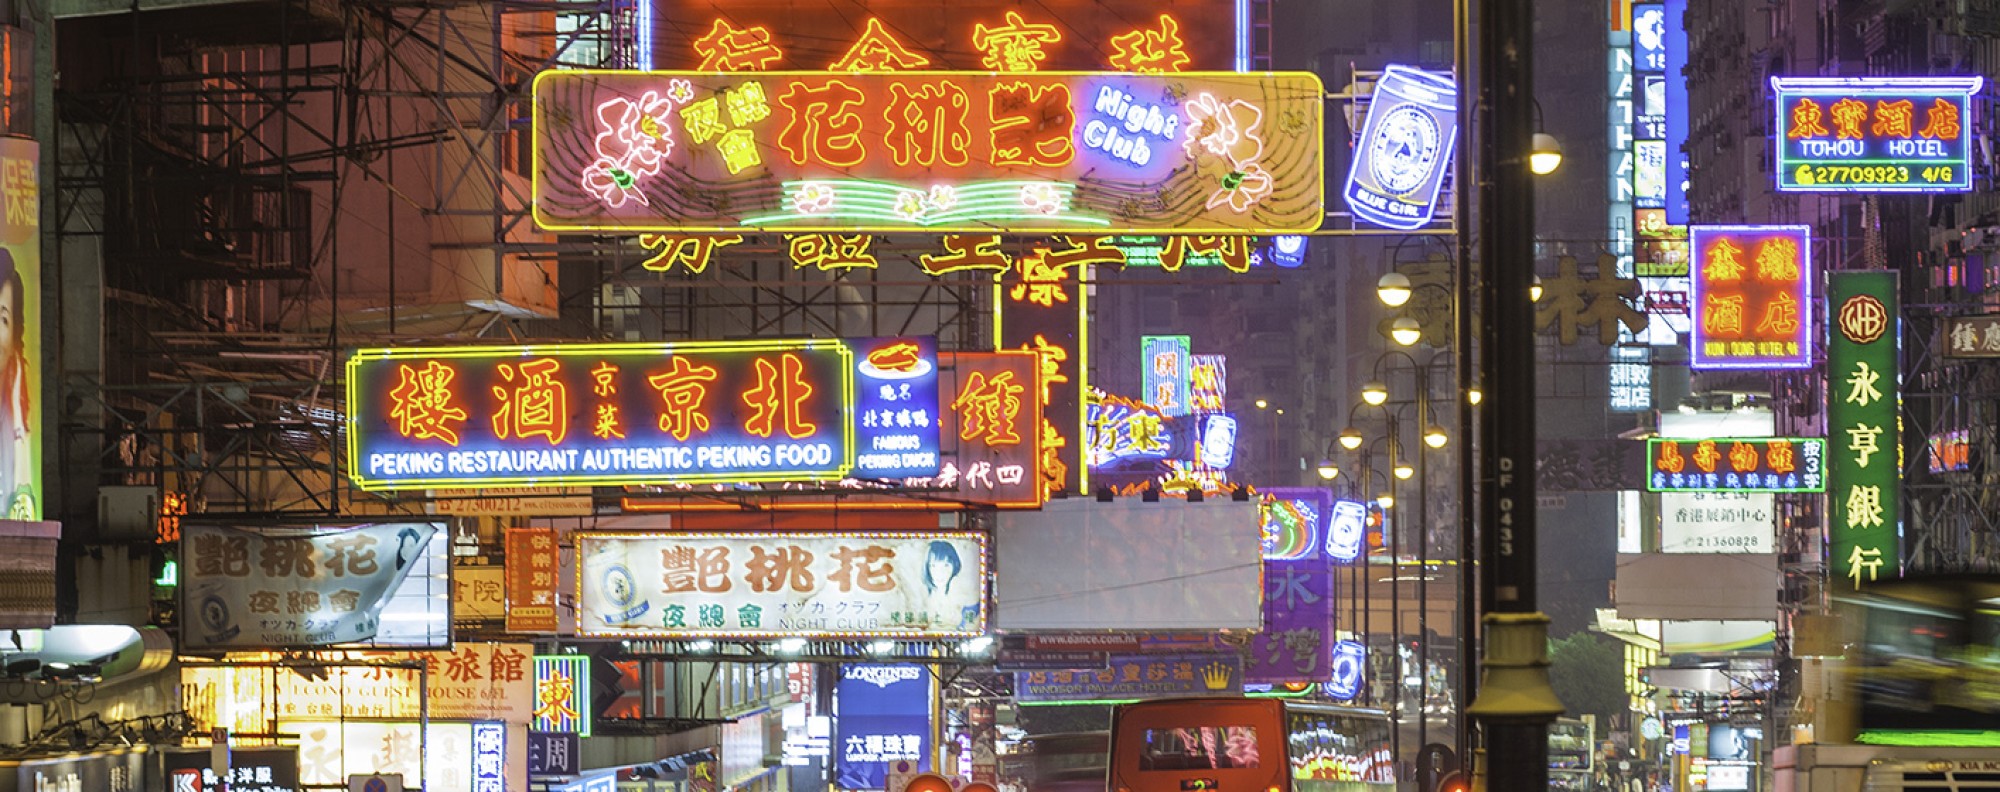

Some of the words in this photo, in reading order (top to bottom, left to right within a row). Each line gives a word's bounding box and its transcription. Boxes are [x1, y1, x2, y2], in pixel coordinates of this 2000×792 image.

[1083, 120, 1150, 165] Club
[1800, 139, 1865, 157] TOHOU
[1889, 139, 1948, 157] HOTEL
[1815, 166, 1909, 183] 27709323
[1356, 188, 1387, 210] BLUE
[1704, 290, 1799, 334] 酒店
[872, 435, 921, 451] FAMOUS
[370, 453, 443, 475] PEKING
[447, 450, 578, 473] RESTAURANT
[582, 448, 693, 471] AUTHENTIC
[697, 446, 770, 468] PEKING
[775, 443, 831, 465] FOOD
[858, 453, 902, 469] PEKING
[902, 452, 936, 467] DUCK
[1846, 361, 1884, 591] 永亨銀行
[456, 498, 520, 512] 27300212
[1697, 535, 1758, 547] 21360828
[661, 602, 763, 629] 夜總會
[778, 617, 829, 630] NIGHT
[836, 617, 879, 630] CLUB
[261, 633, 298, 644] NIGHT
[845, 666, 922, 680] LONGINES
[1029, 684, 1082, 694] WINDSOR
[1140, 683, 1177, 693] HOTEL
[533, 669, 580, 726] 東
[845, 734, 922, 754] 六福珠寶
[1960, 761, 1980, 770] KIA
